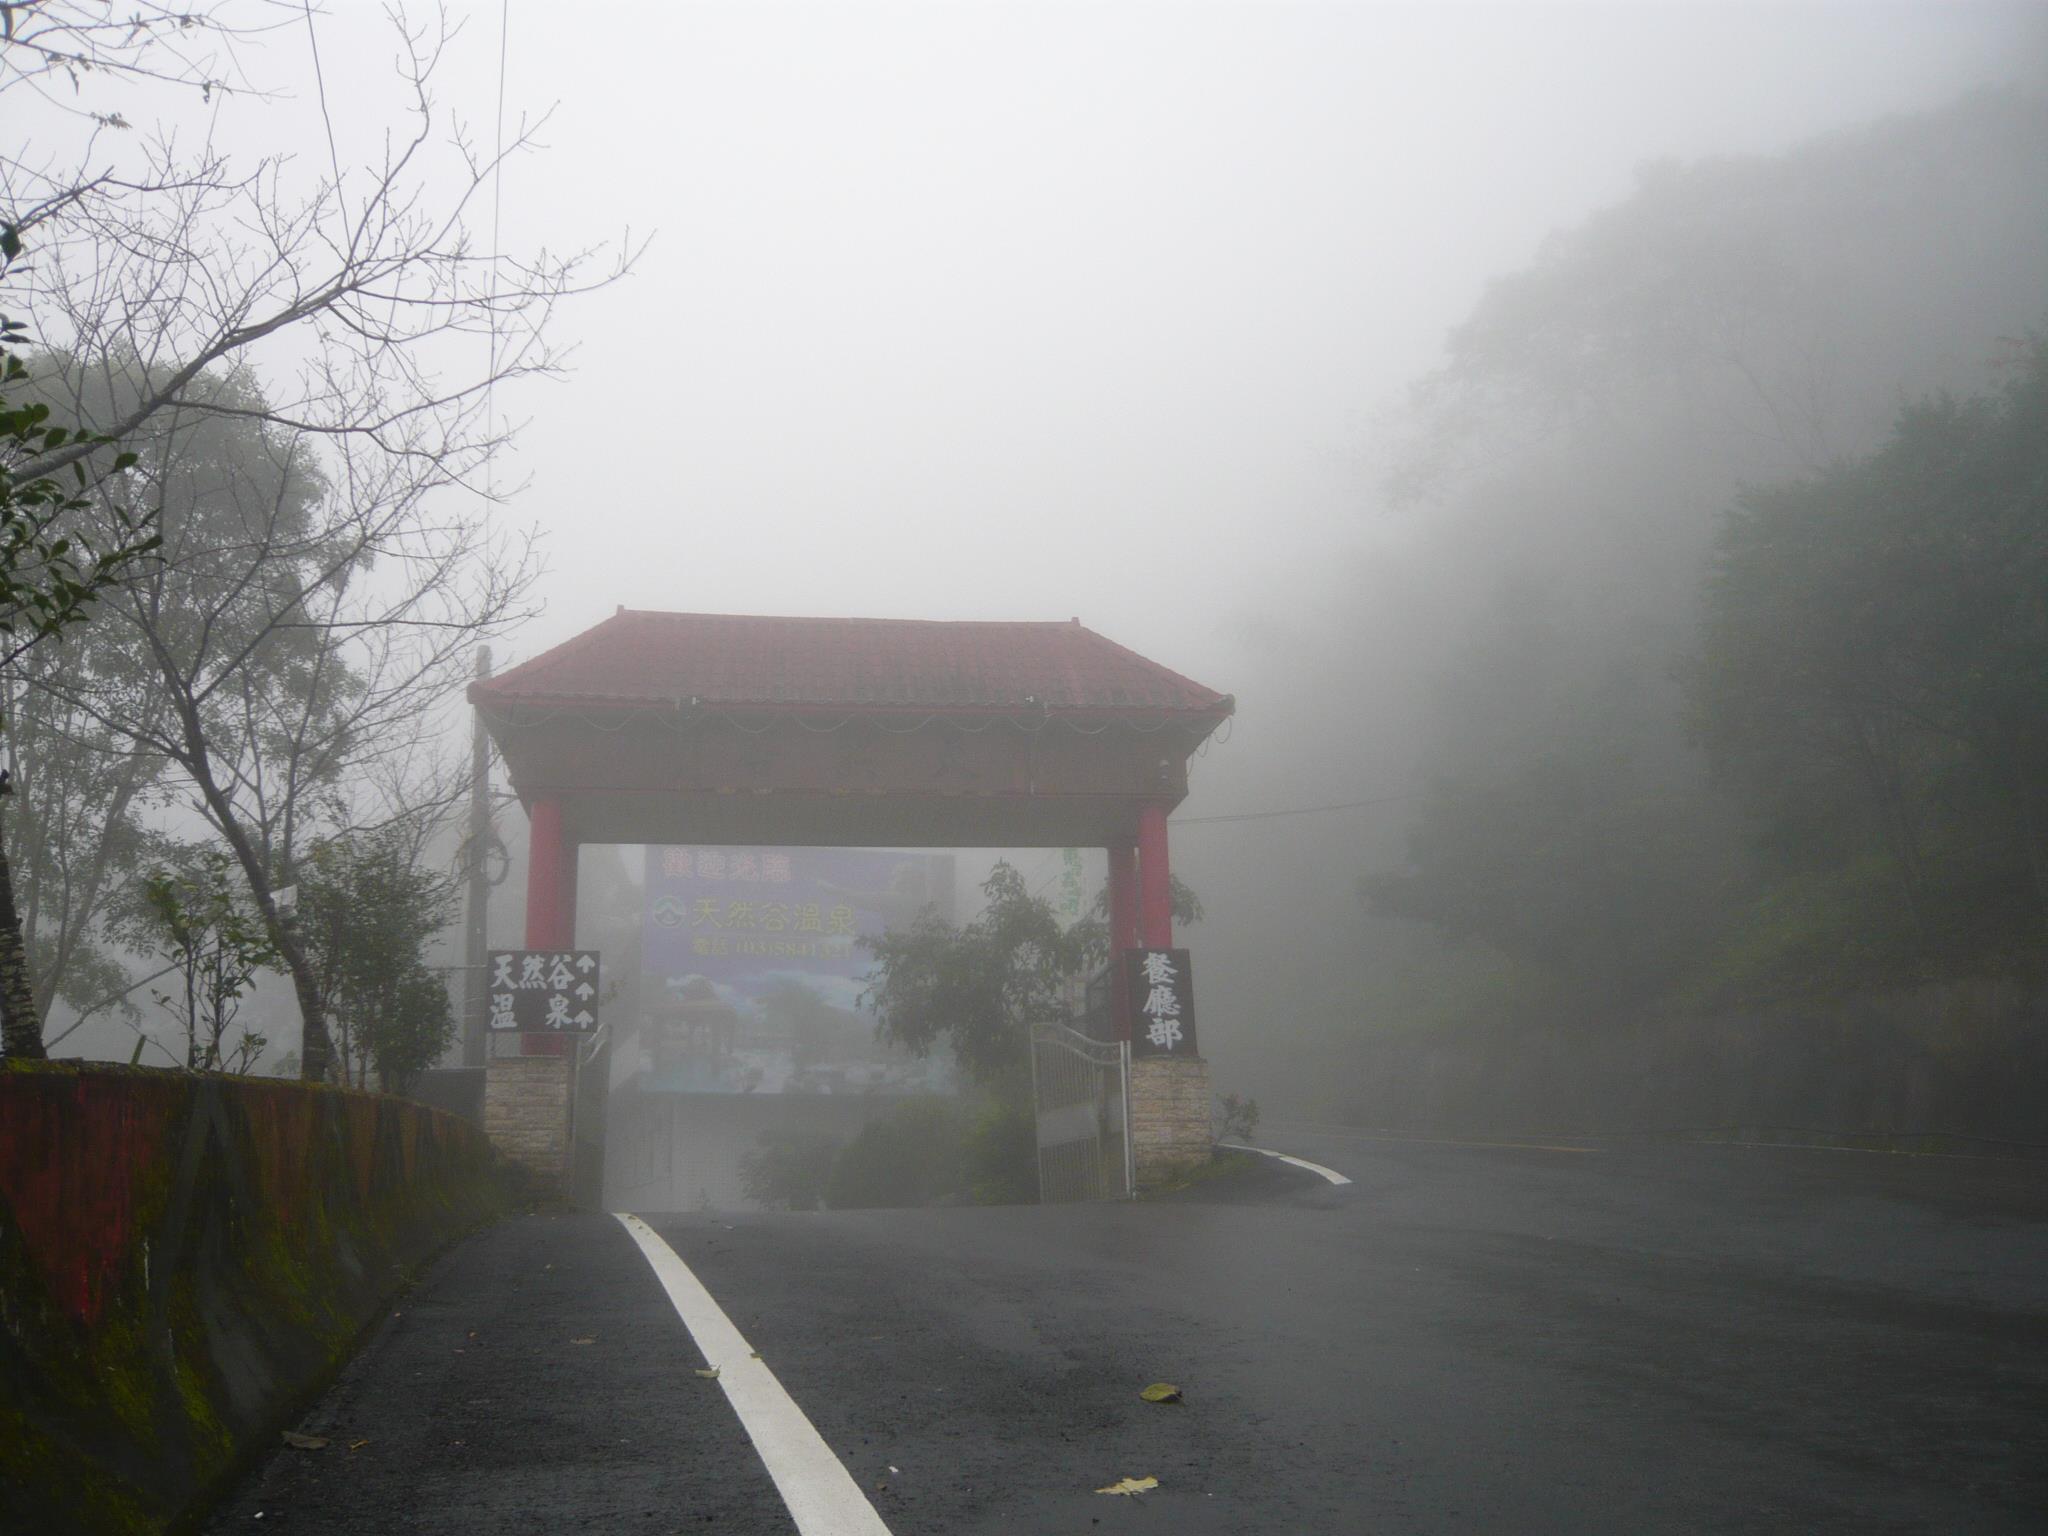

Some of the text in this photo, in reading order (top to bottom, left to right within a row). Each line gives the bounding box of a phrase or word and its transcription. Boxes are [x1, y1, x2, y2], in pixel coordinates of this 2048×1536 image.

[490, 954, 575, 990] 天然谷
[1139, 952, 1184, 1051] 餐廳部
